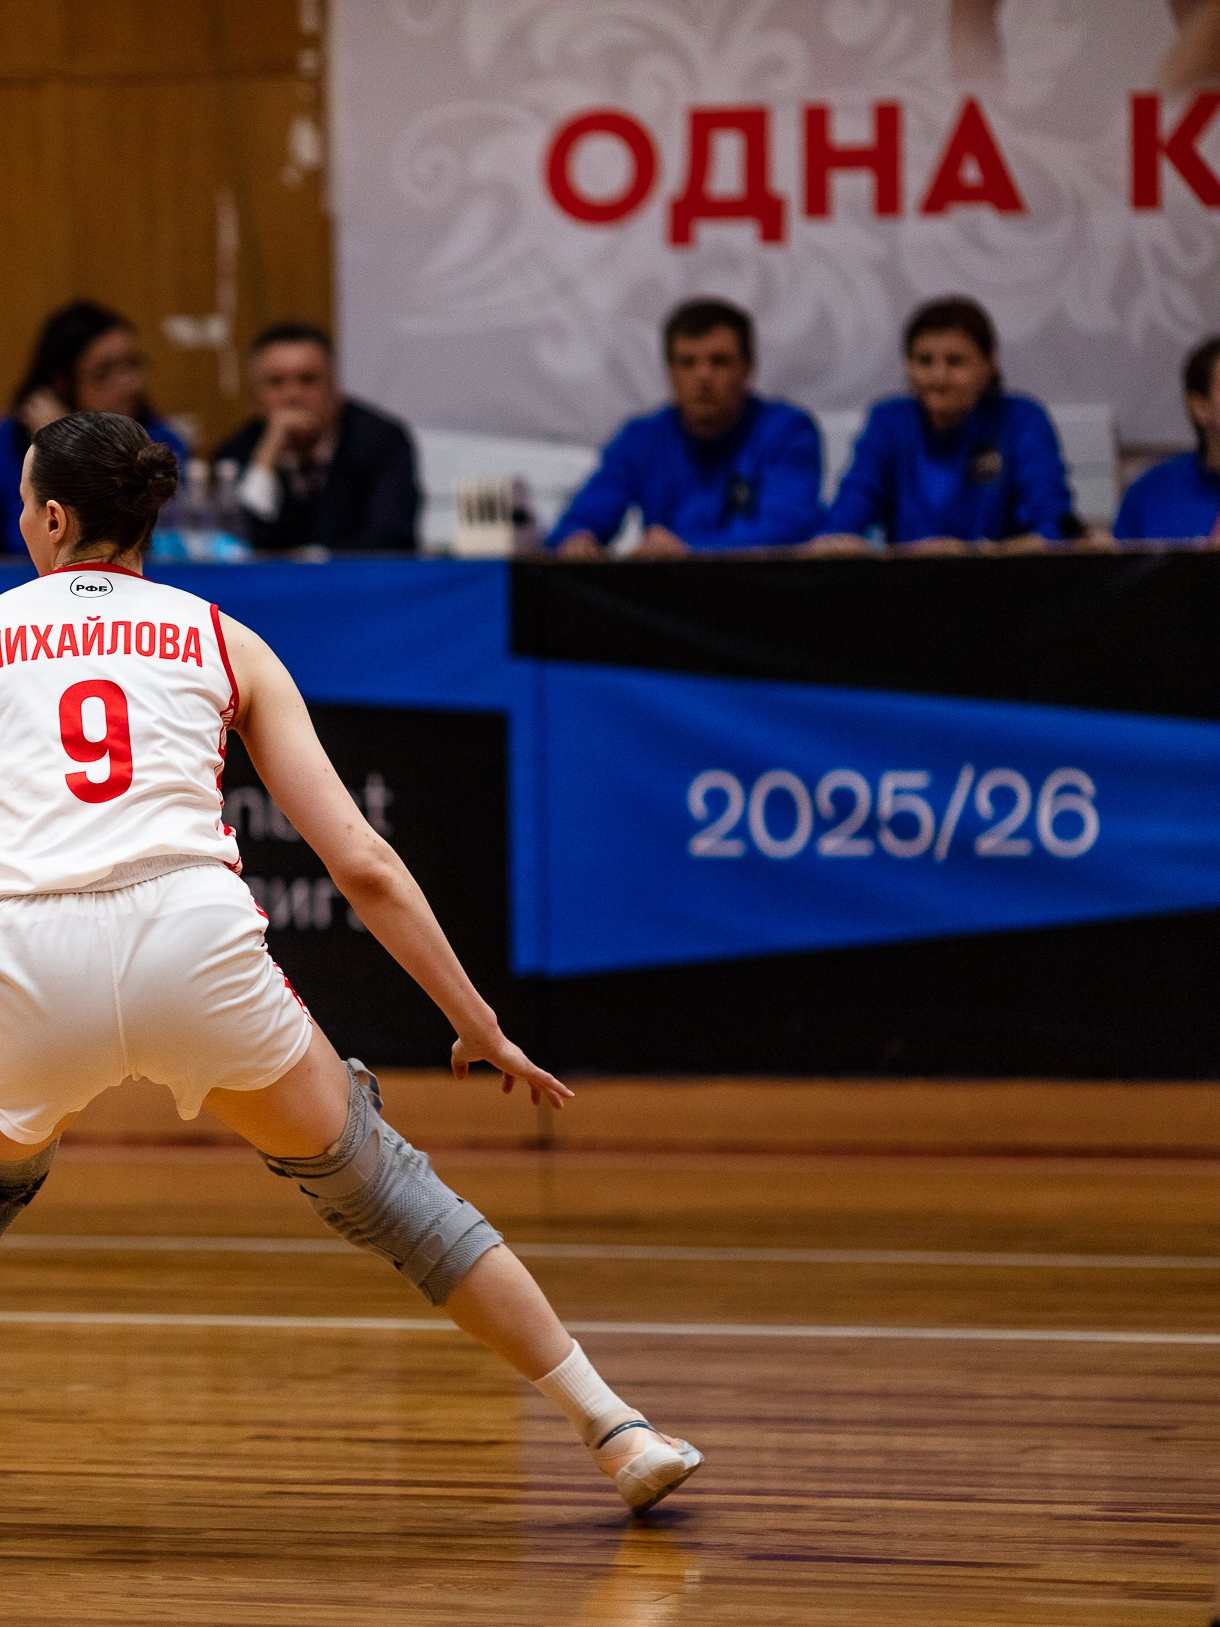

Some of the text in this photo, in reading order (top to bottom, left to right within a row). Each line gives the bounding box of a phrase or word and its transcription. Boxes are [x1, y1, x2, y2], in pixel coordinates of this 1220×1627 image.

[543, 97, 1027, 249] ОДНА
[76, 584, 108, 592] РФБ
[59, 679, 133, 804] 9
[686, 763, 1101, 862] 2025/26
